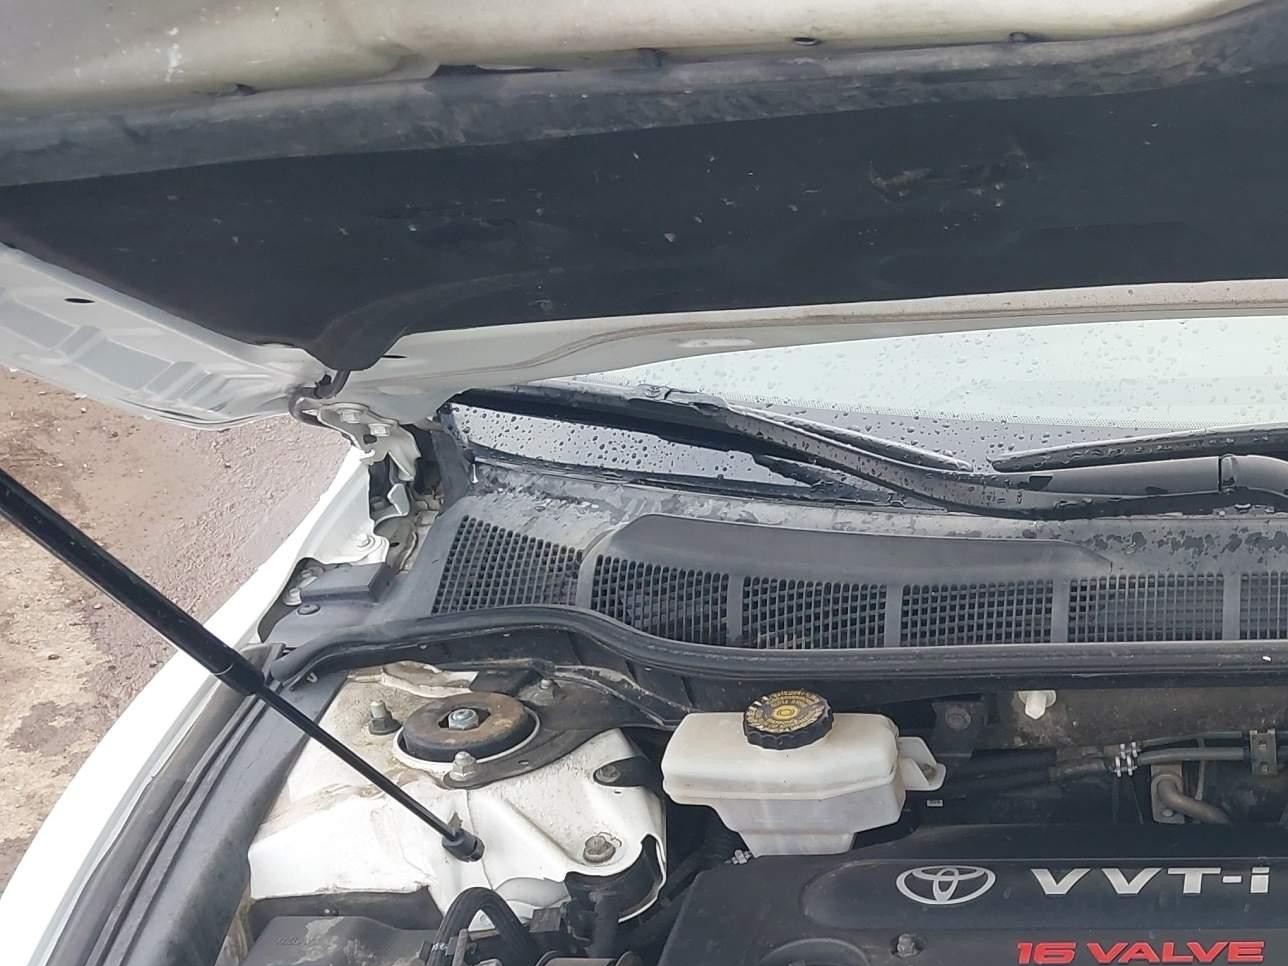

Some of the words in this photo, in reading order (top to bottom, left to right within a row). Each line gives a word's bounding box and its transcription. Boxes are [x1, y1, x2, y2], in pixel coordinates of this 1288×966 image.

[1030, 866, 1270, 895] VVT-i
[1017, 941, 1077, 965] 16
[1086, 940, 1265, 965] VALVE
